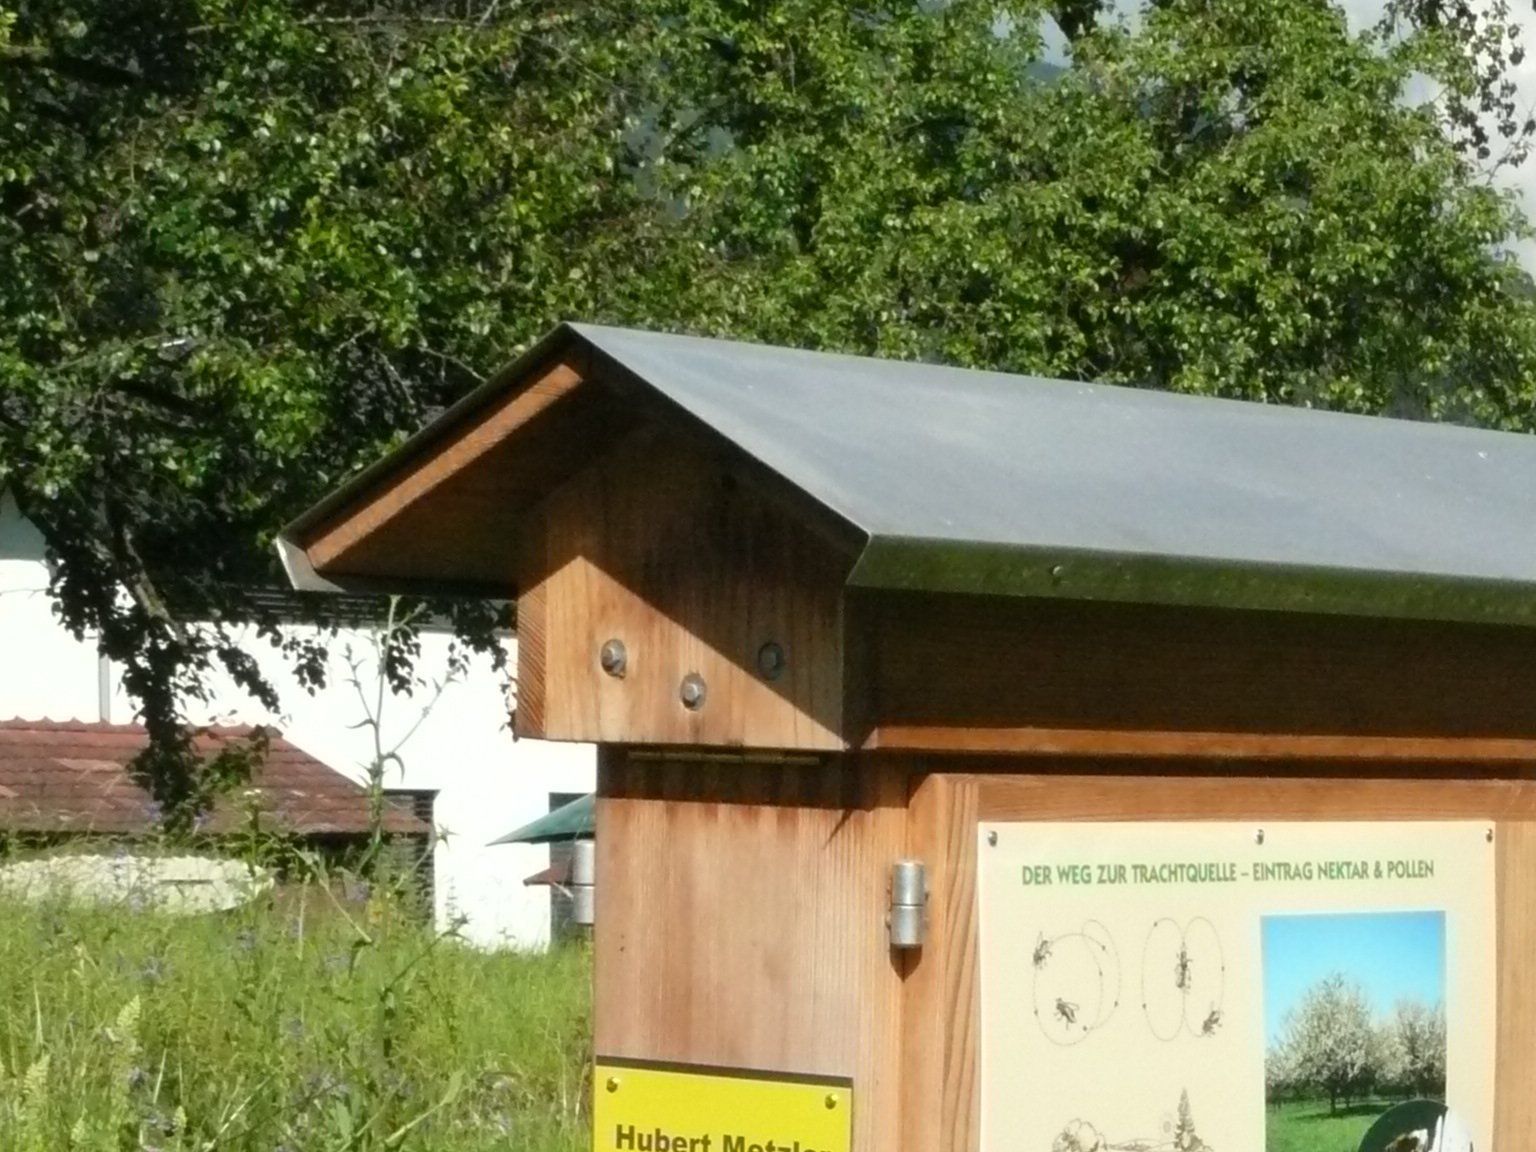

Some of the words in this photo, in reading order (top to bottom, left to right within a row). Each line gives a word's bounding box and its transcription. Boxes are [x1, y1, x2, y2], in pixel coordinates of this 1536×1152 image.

[1022, 865, 1052, 885] DER
[1057, 864, 1092, 885] WEG
[1097, 864, 1127, 884] ZUR
[1131, 863, 1237, 884] TRACHTQUELLE
[1253, 861, 1313, 881] EINTRAG
[1317, 861, 1369, 880] NEKTAR
[1373, 860, 1383, 879] &
[1387, 859, 1434, 879] POLLEN
